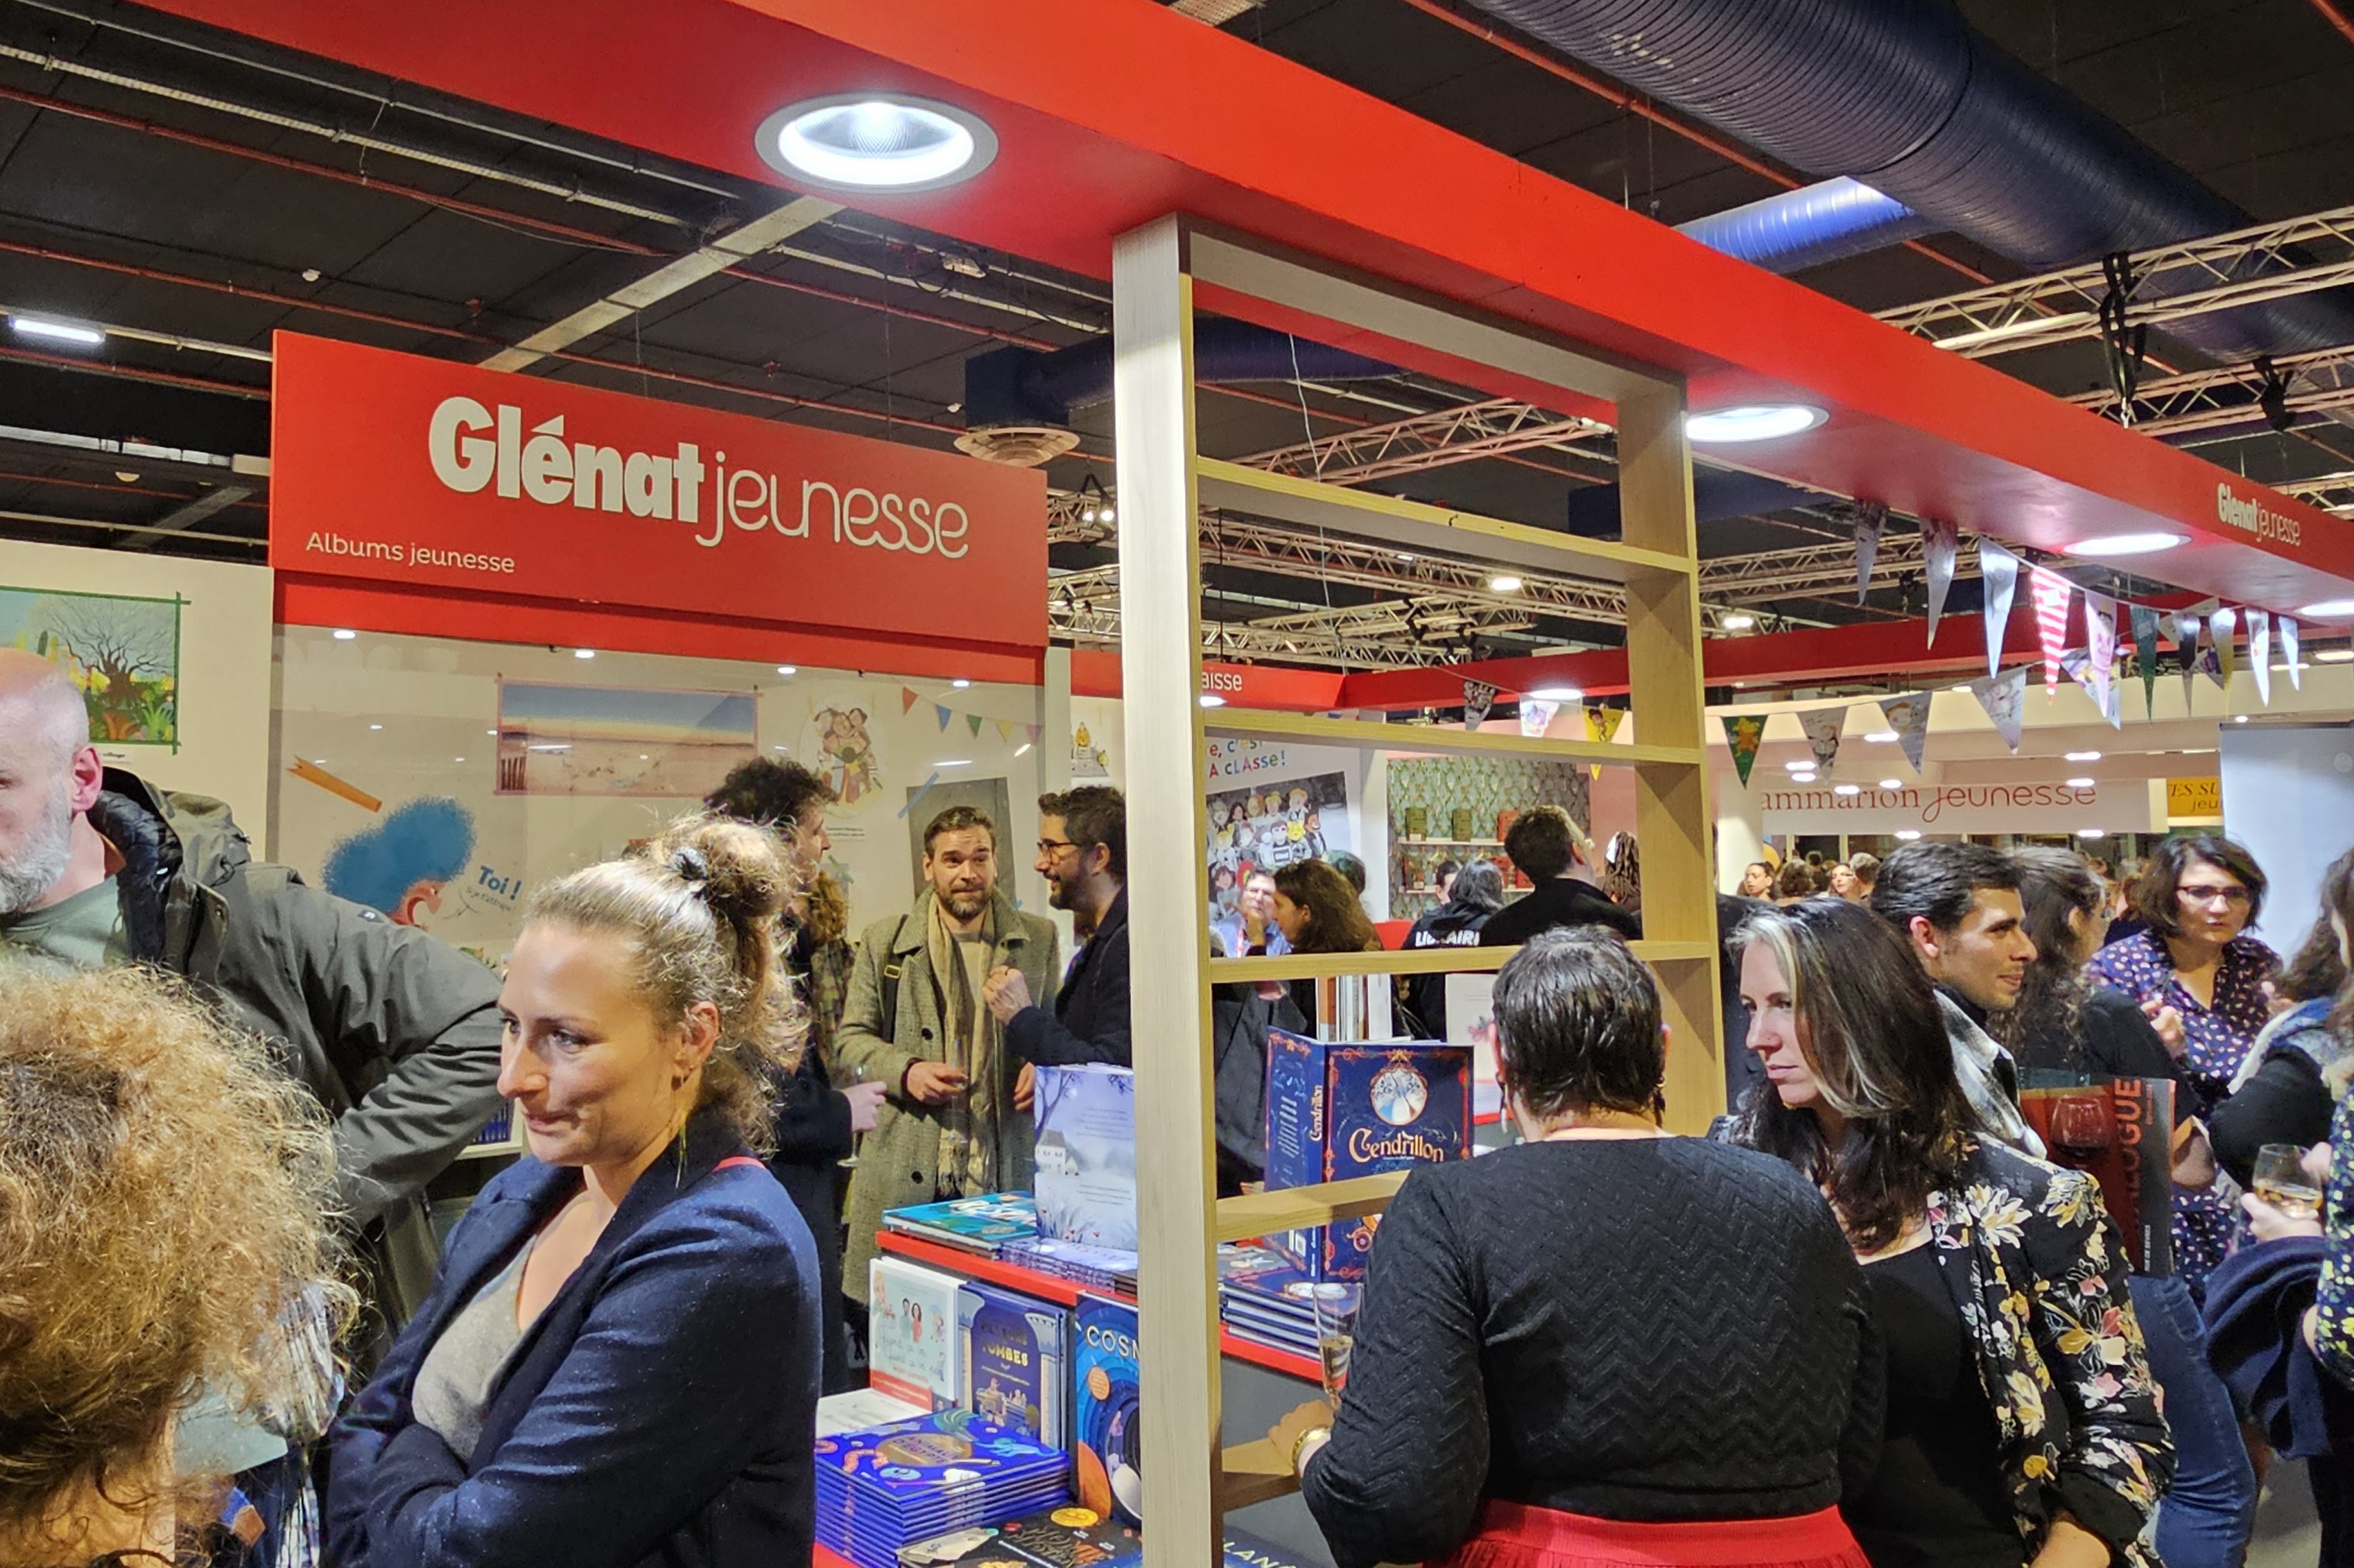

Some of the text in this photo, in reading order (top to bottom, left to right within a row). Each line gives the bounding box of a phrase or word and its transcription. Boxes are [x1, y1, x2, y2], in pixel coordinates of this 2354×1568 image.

[428, 396, 969, 559] Glénat jeunesse
[2256, 502, 2301, 546] jeunesse
[306, 532, 515, 573] Albums jeunesse
[1922, 785, 2096, 823] jeunesse
[478, 864, 510, 895] Toi
[1308, 1085, 1324, 1142] Cendrillon
[1349, 1127, 1444, 1163] Cendrillon
